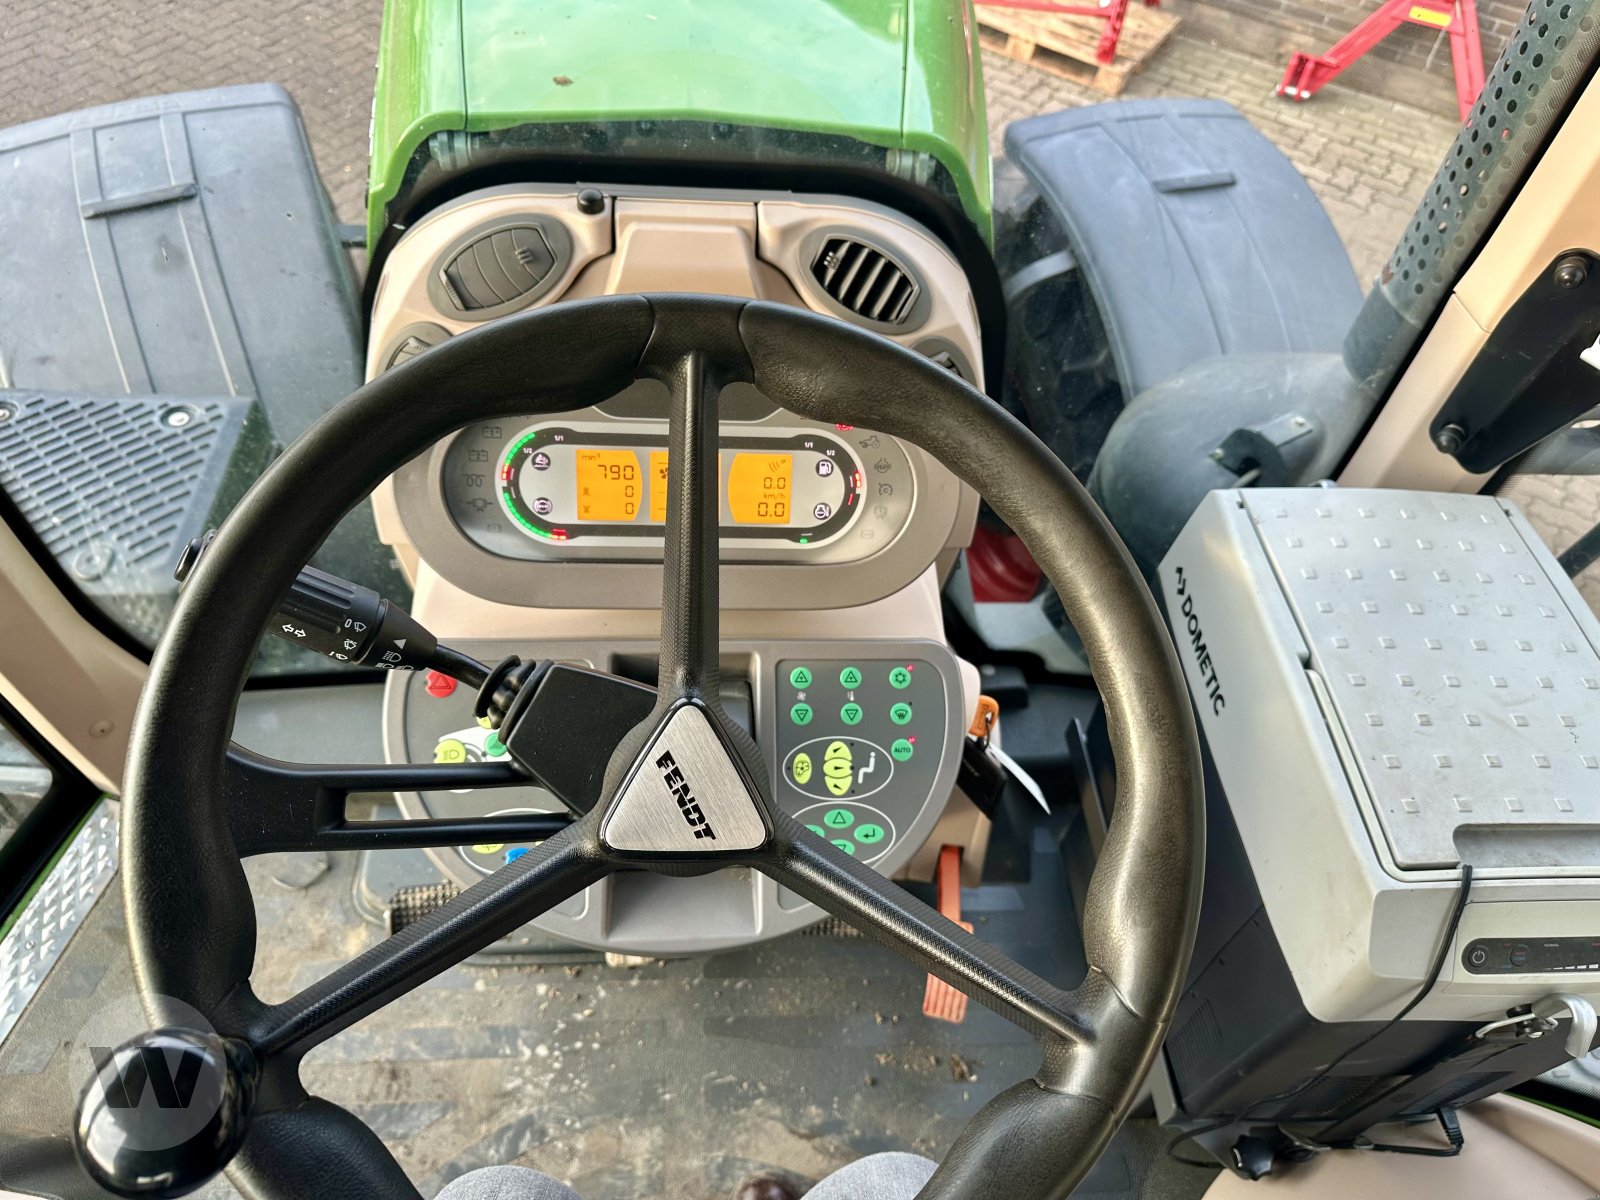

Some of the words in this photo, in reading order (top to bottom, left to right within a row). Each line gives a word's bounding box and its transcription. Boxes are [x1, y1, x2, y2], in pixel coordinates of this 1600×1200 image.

[597, 464, 634, 481] 790
[763, 476, 786, 490] 0.0
[624, 485, 634, 498] 0
[624, 502, 634, 515] 0
[757, 502, 785, 518] 0.0
[1181, 594, 1226, 717] DOMETIC
[655, 750, 717, 841] FENDT
